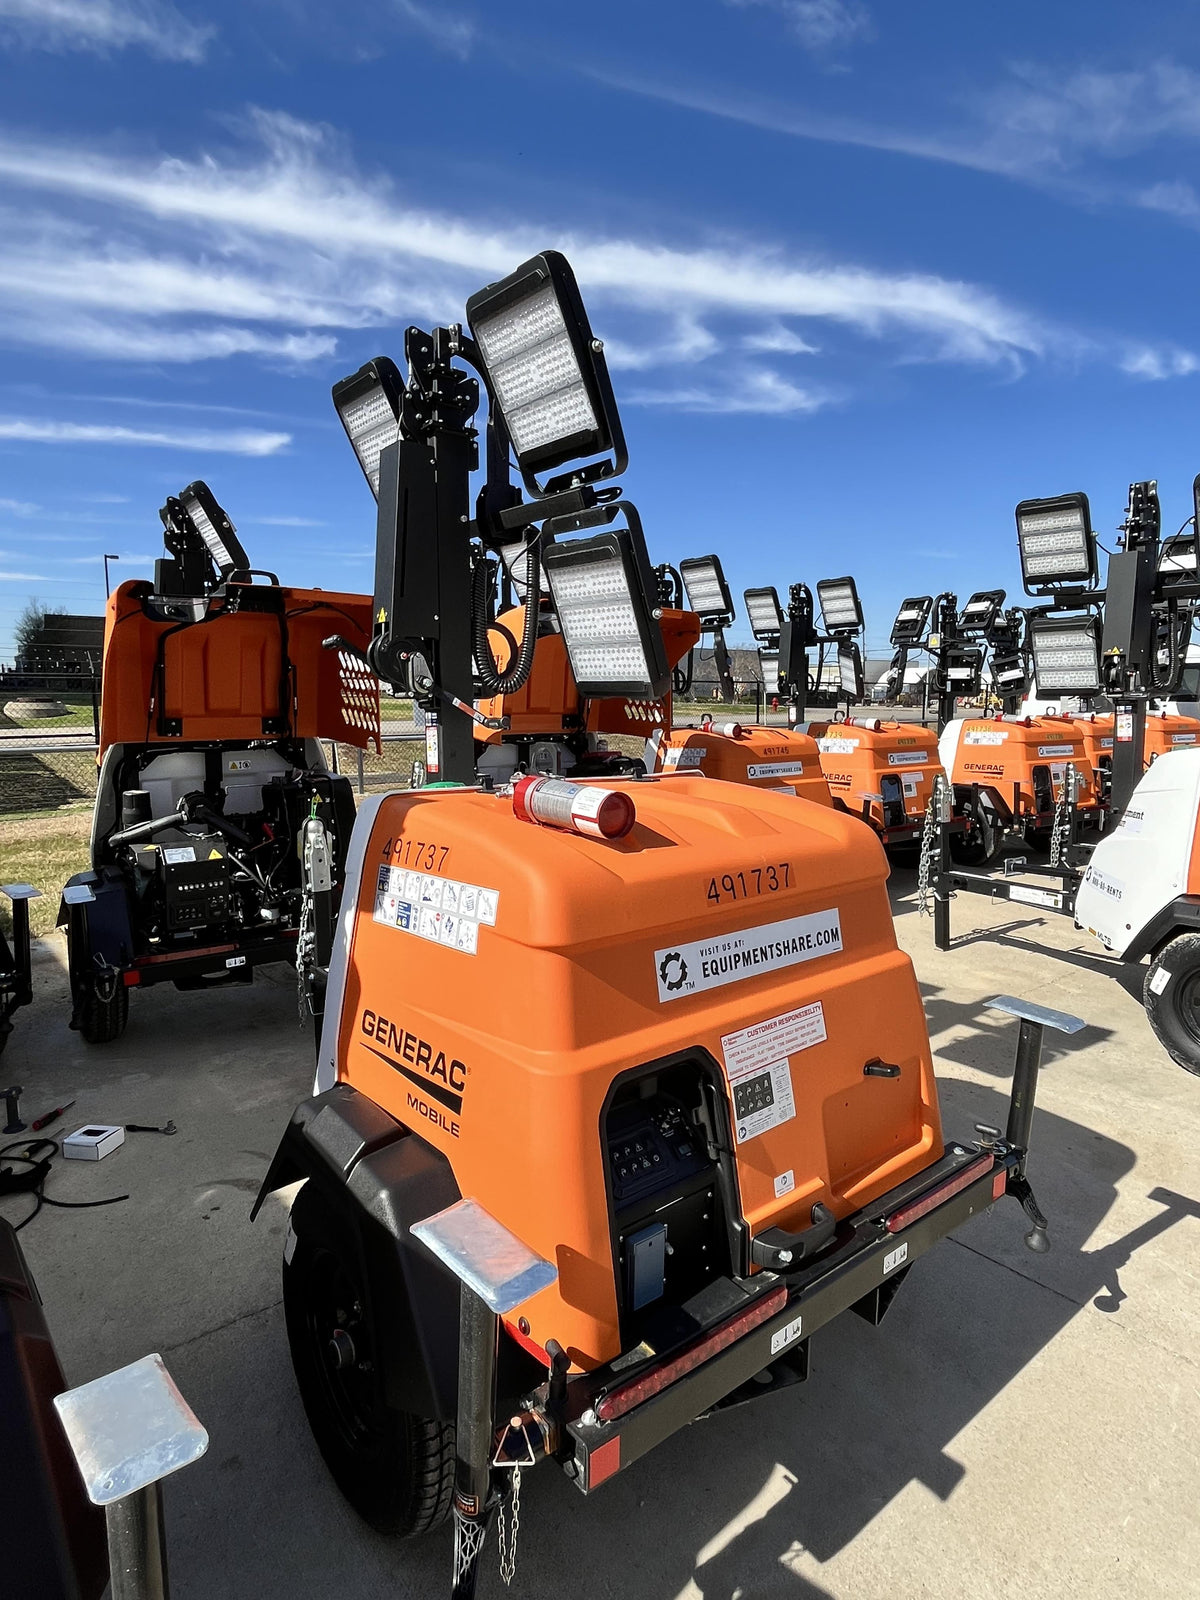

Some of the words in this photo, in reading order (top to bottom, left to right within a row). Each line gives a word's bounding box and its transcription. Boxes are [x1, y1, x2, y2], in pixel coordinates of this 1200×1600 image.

[822, 773, 853, 781] NERAC
[963, 763, 1005, 772] GENERAC
[382, 837, 450, 872] 491737
[707, 863, 790, 903] 491737
[700, 945, 719, 957] VISIT
[722, 942, 731, 951] US
[734, 939, 745, 948] AT:
[702, 927, 840, 978] EQUIPMENTSHARE.COM
[685, 980, 696, 990] TM
[746, 1020, 778, 1038] CUSTOMER
[361, 1009, 466, 1092] GENERAC
[407, 1092, 460, 1138] MOBILE
